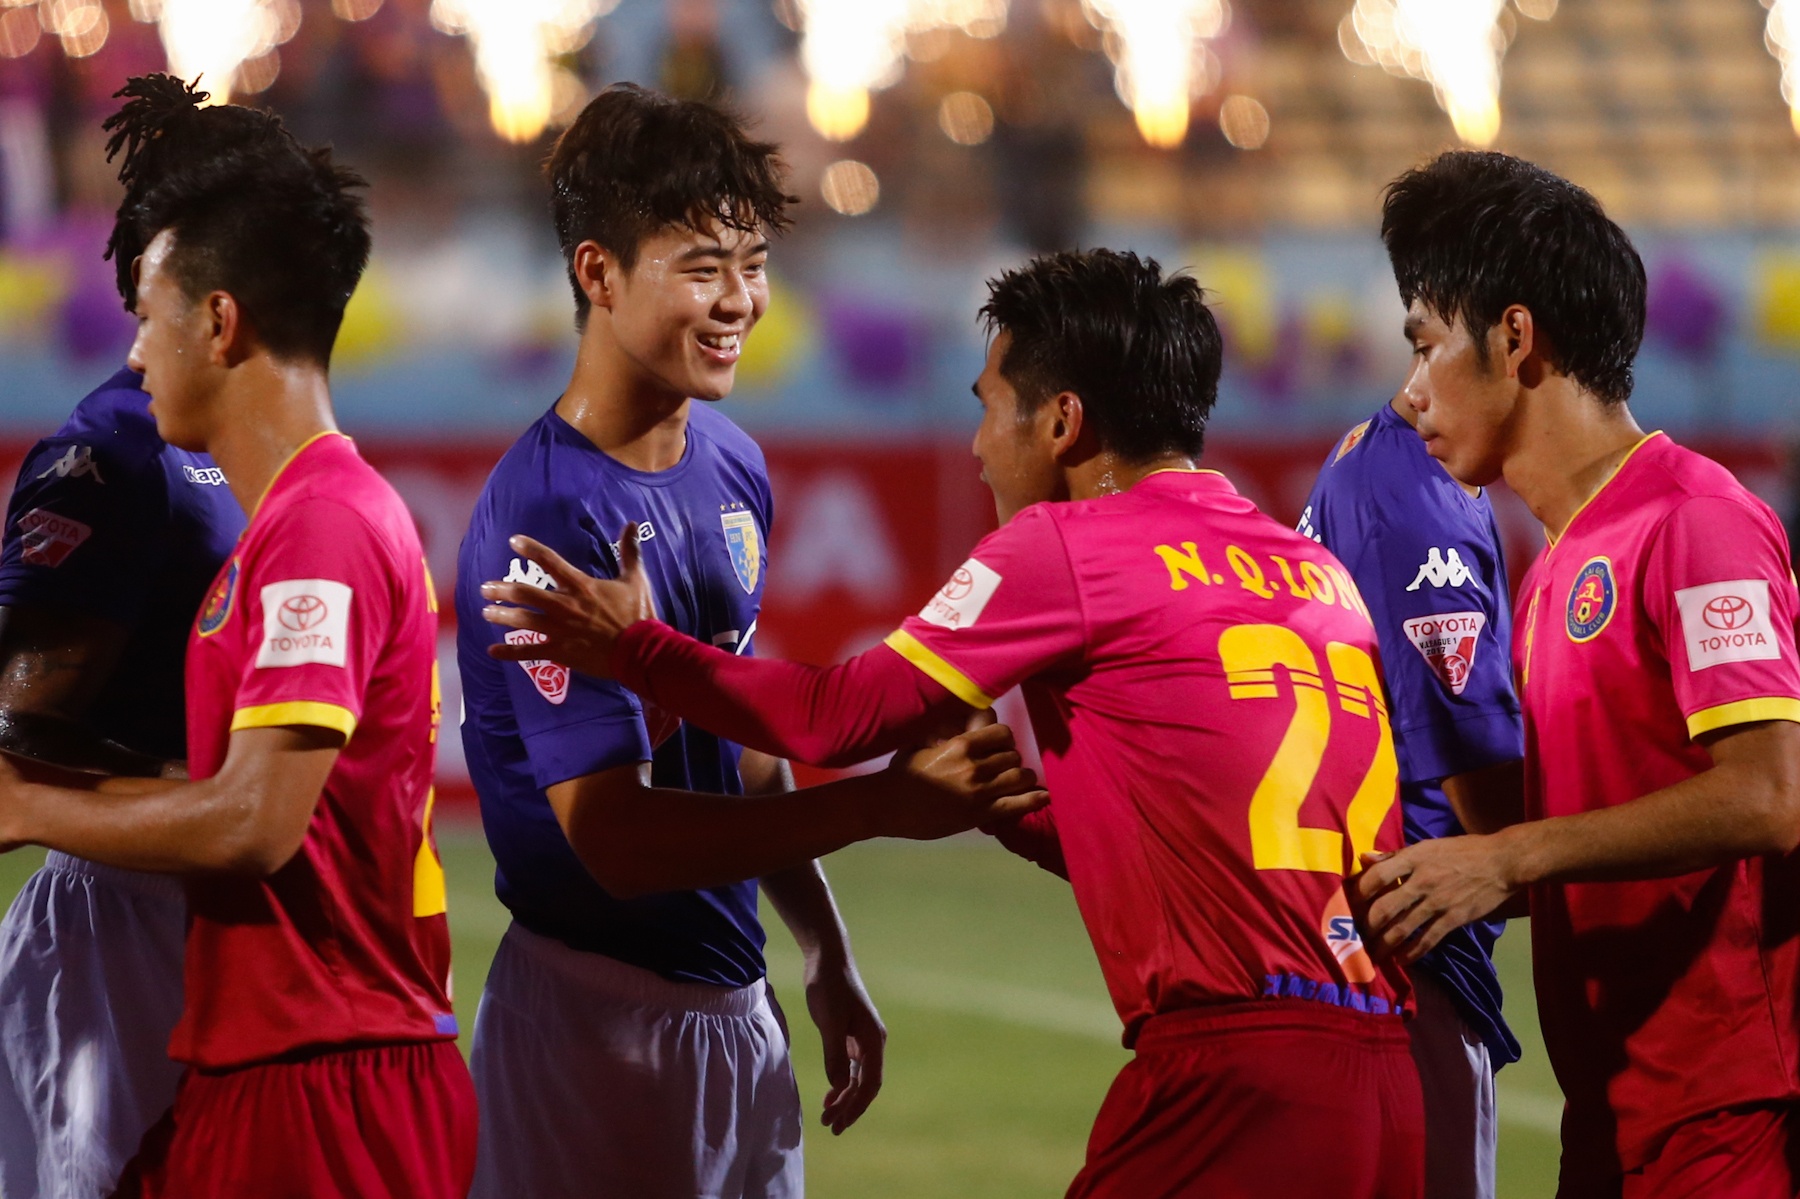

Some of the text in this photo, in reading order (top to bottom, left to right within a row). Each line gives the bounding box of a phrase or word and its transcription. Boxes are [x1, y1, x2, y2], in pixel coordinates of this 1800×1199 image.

[1409, 618, 1477, 638] TOYOTA
[1589, 612, 1605, 631] CLUB
[269, 634, 333, 652] TOYOTA
[1426, 647, 1446, 655] 2017
[1699, 632, 1767, 652] TOYOTA
